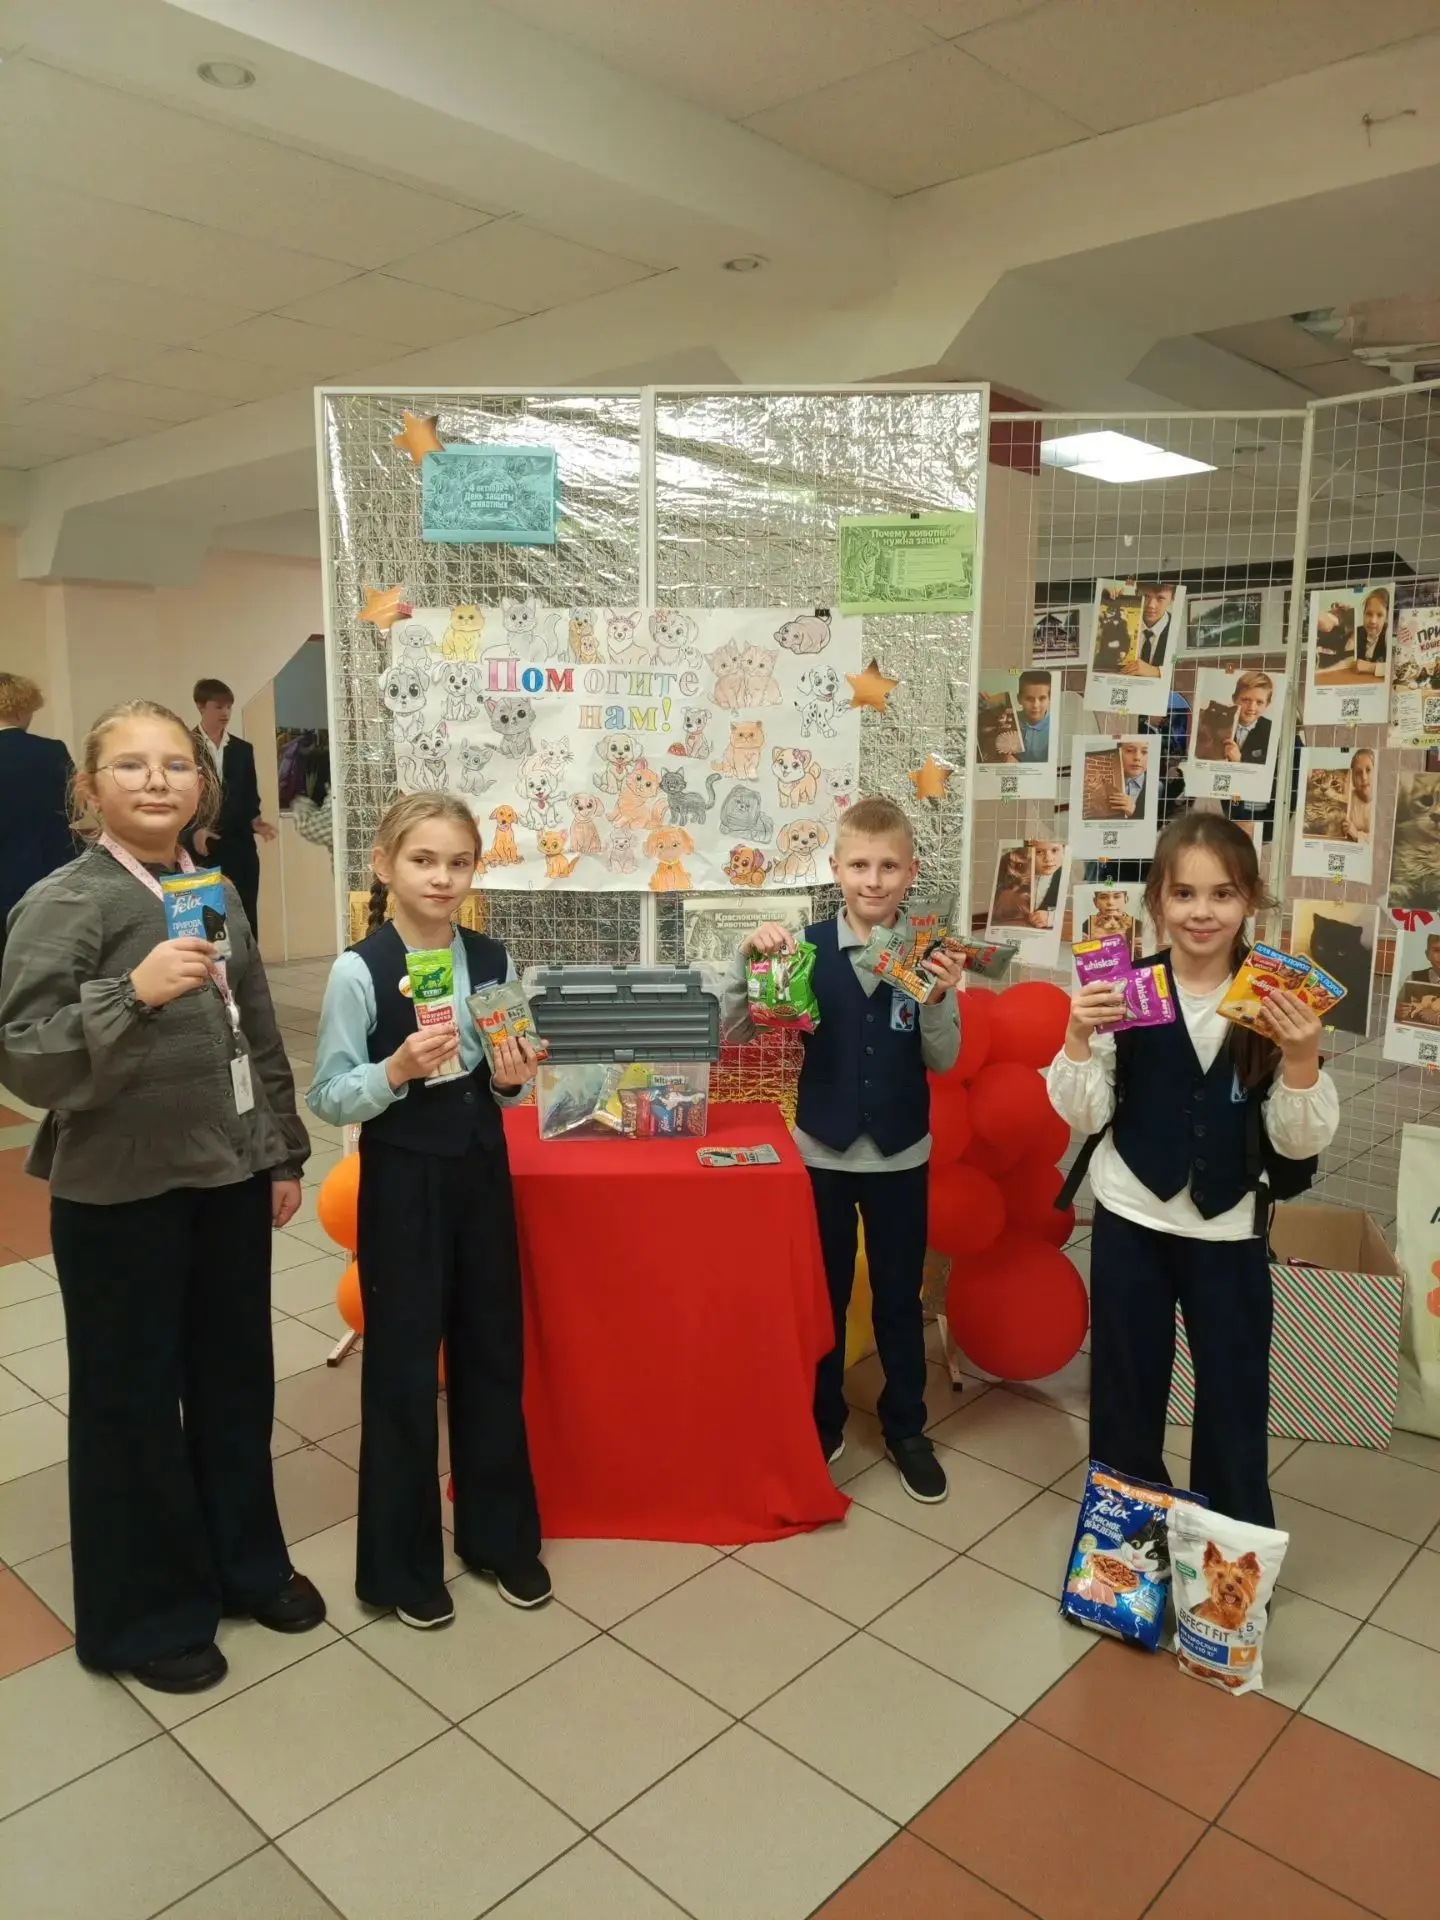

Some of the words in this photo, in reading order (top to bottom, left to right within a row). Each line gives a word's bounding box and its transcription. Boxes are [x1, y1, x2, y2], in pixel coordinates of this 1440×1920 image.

[464, 492, 484, 502] День
[485, 493, 514, 501] защиты
[470, 501, 508, 509] животных
[871, 529, 908, 539] Почему
[883, 538, 914, 547] нужна
[578, 697, 672, 732] нам!
[716, 921, 759, 929] животные
[1084, 958, 1120, 971] whiskas
[1255, 945, 1271, 955] ДЛЯ
[1287, 957, 1311, 971] ПОРОД
[1135, 978, 1150, 1016] whiskas
[1090, 1500, 1131, 1520] felix
[1084, 1520, 1123, 1542] ОБЪЕДЕНИЕ
[1091, 1513, 1121, 1532] МЯСНОЕ
[1178, 1607, 1210, 1637] ERFECT
[1212, 1627, 1230, 1643] FIT
